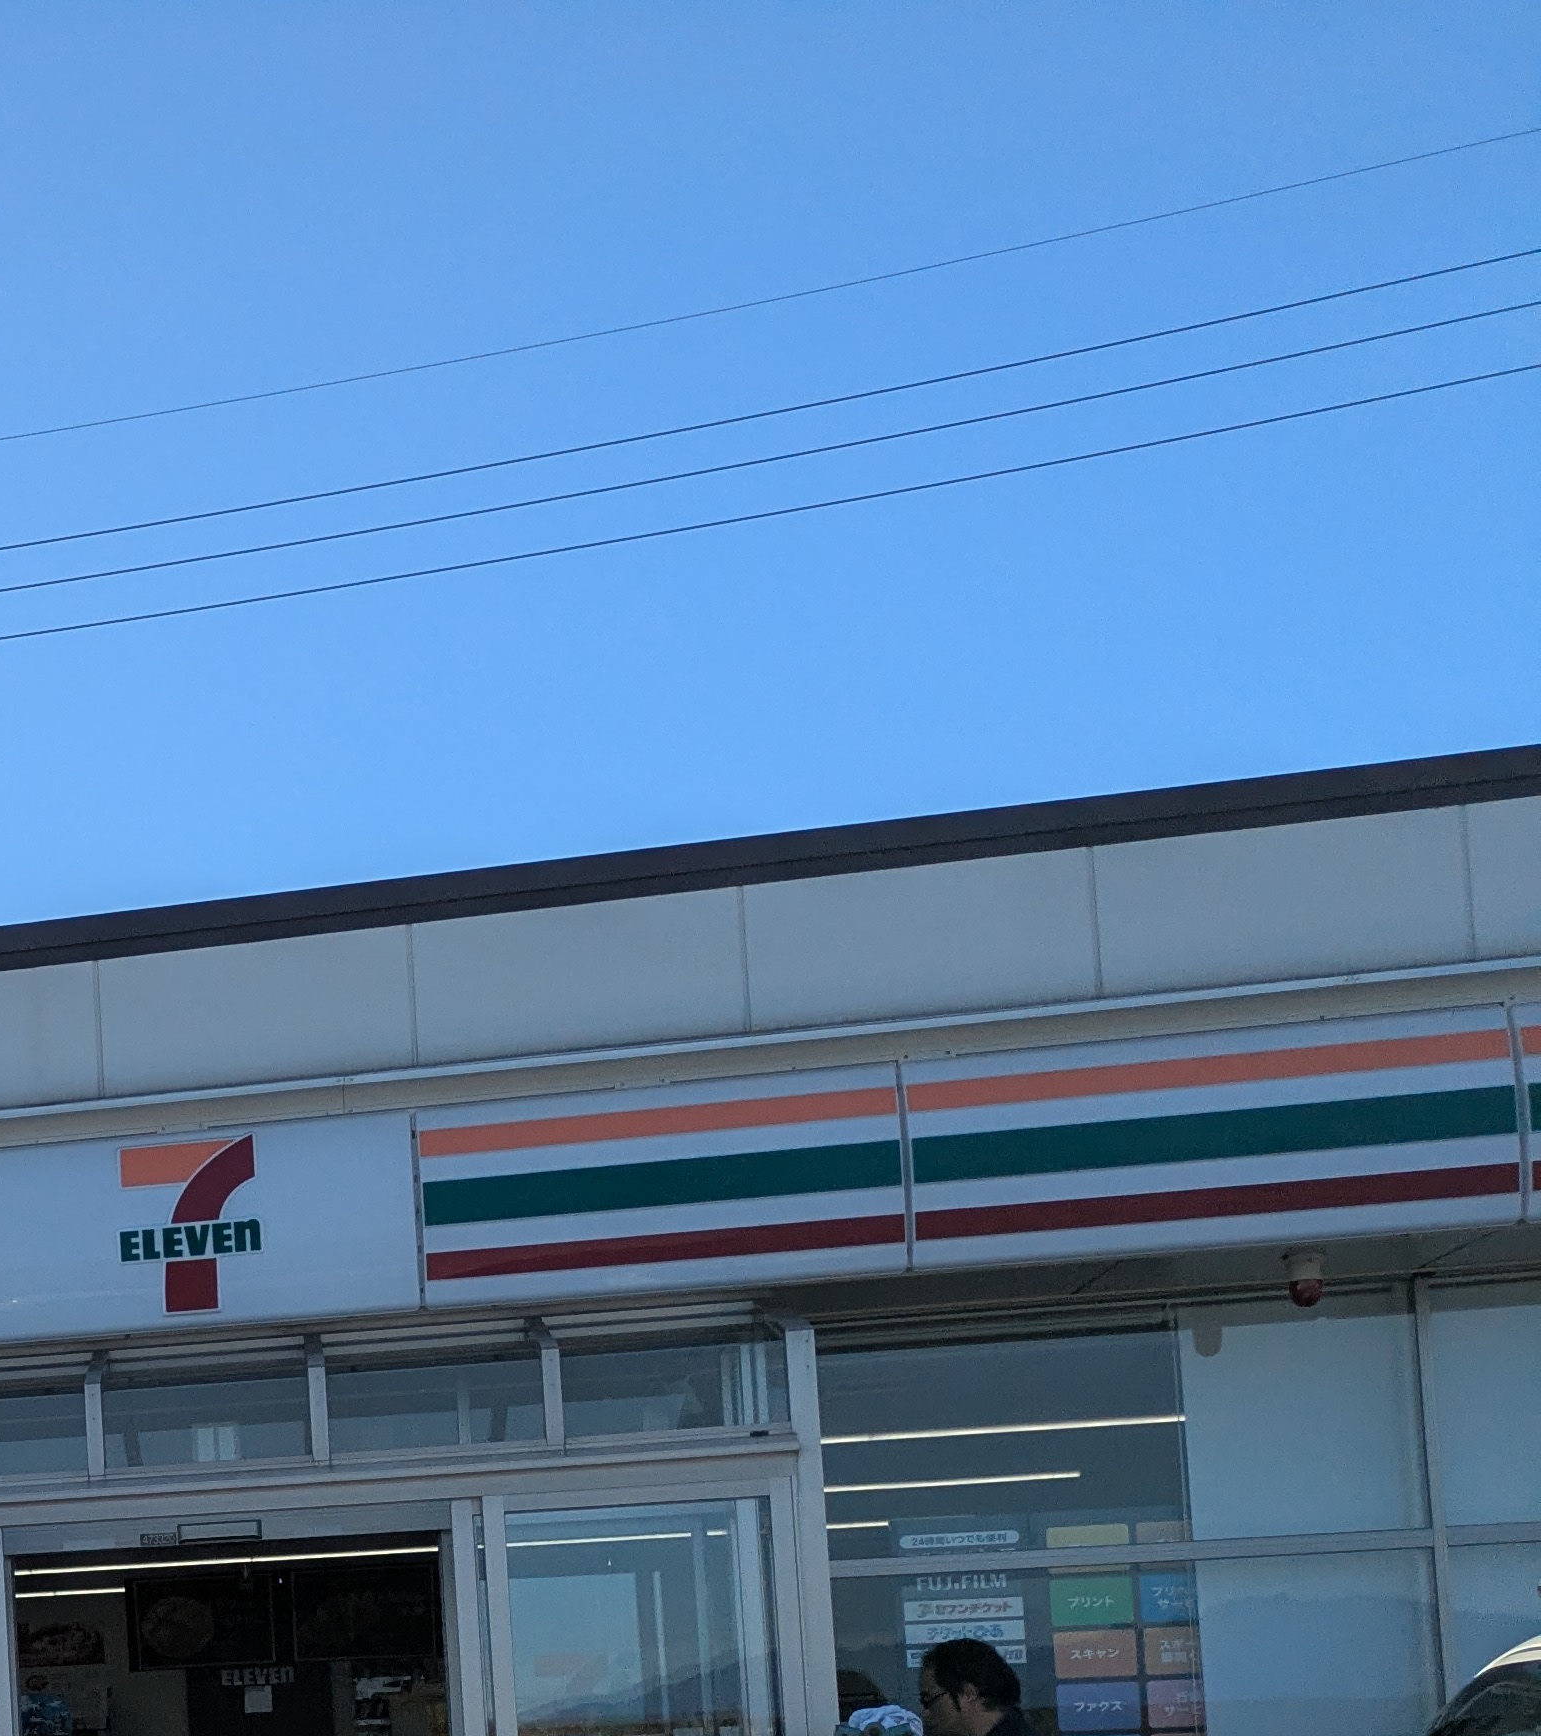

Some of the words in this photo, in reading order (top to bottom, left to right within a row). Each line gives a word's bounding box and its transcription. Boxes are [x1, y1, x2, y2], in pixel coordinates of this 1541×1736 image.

[1066, 1595, 1115, 1610] プリント
[1070, 1648, 1120, 1661] スキャン
[1073, 1700, 1124, 1712] ファクス
